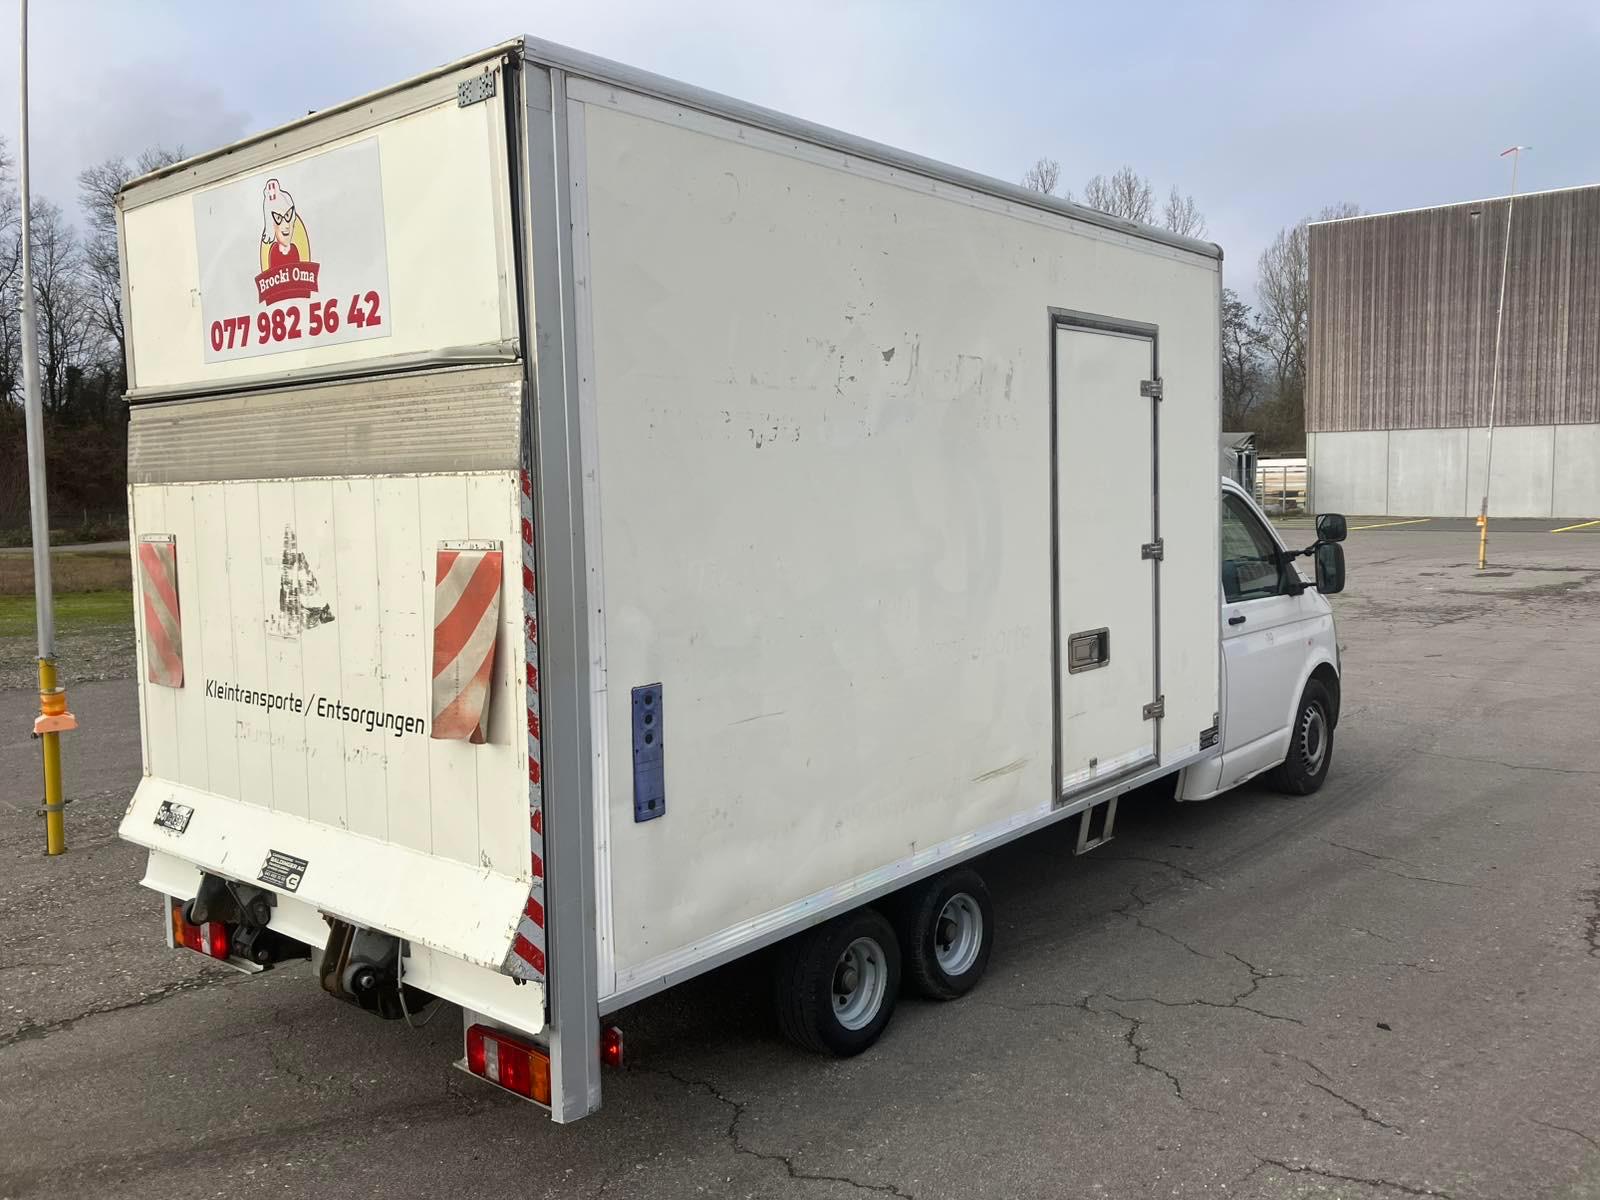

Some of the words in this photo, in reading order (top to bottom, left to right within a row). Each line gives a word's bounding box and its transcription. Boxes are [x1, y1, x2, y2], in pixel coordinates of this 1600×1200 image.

[258, 268, 289, 293] Brocki
[292, 267, 316, 283] Oma
[211, 315, 250, 352] 077
[257, 306, 302, 344] 982
[308, 298, 340, 337] 56
[347, 290, 382, 329] 42
[205, 679, 303, 714] Kleintransporte
[317, 697, 425, 738] Entsorgungen
